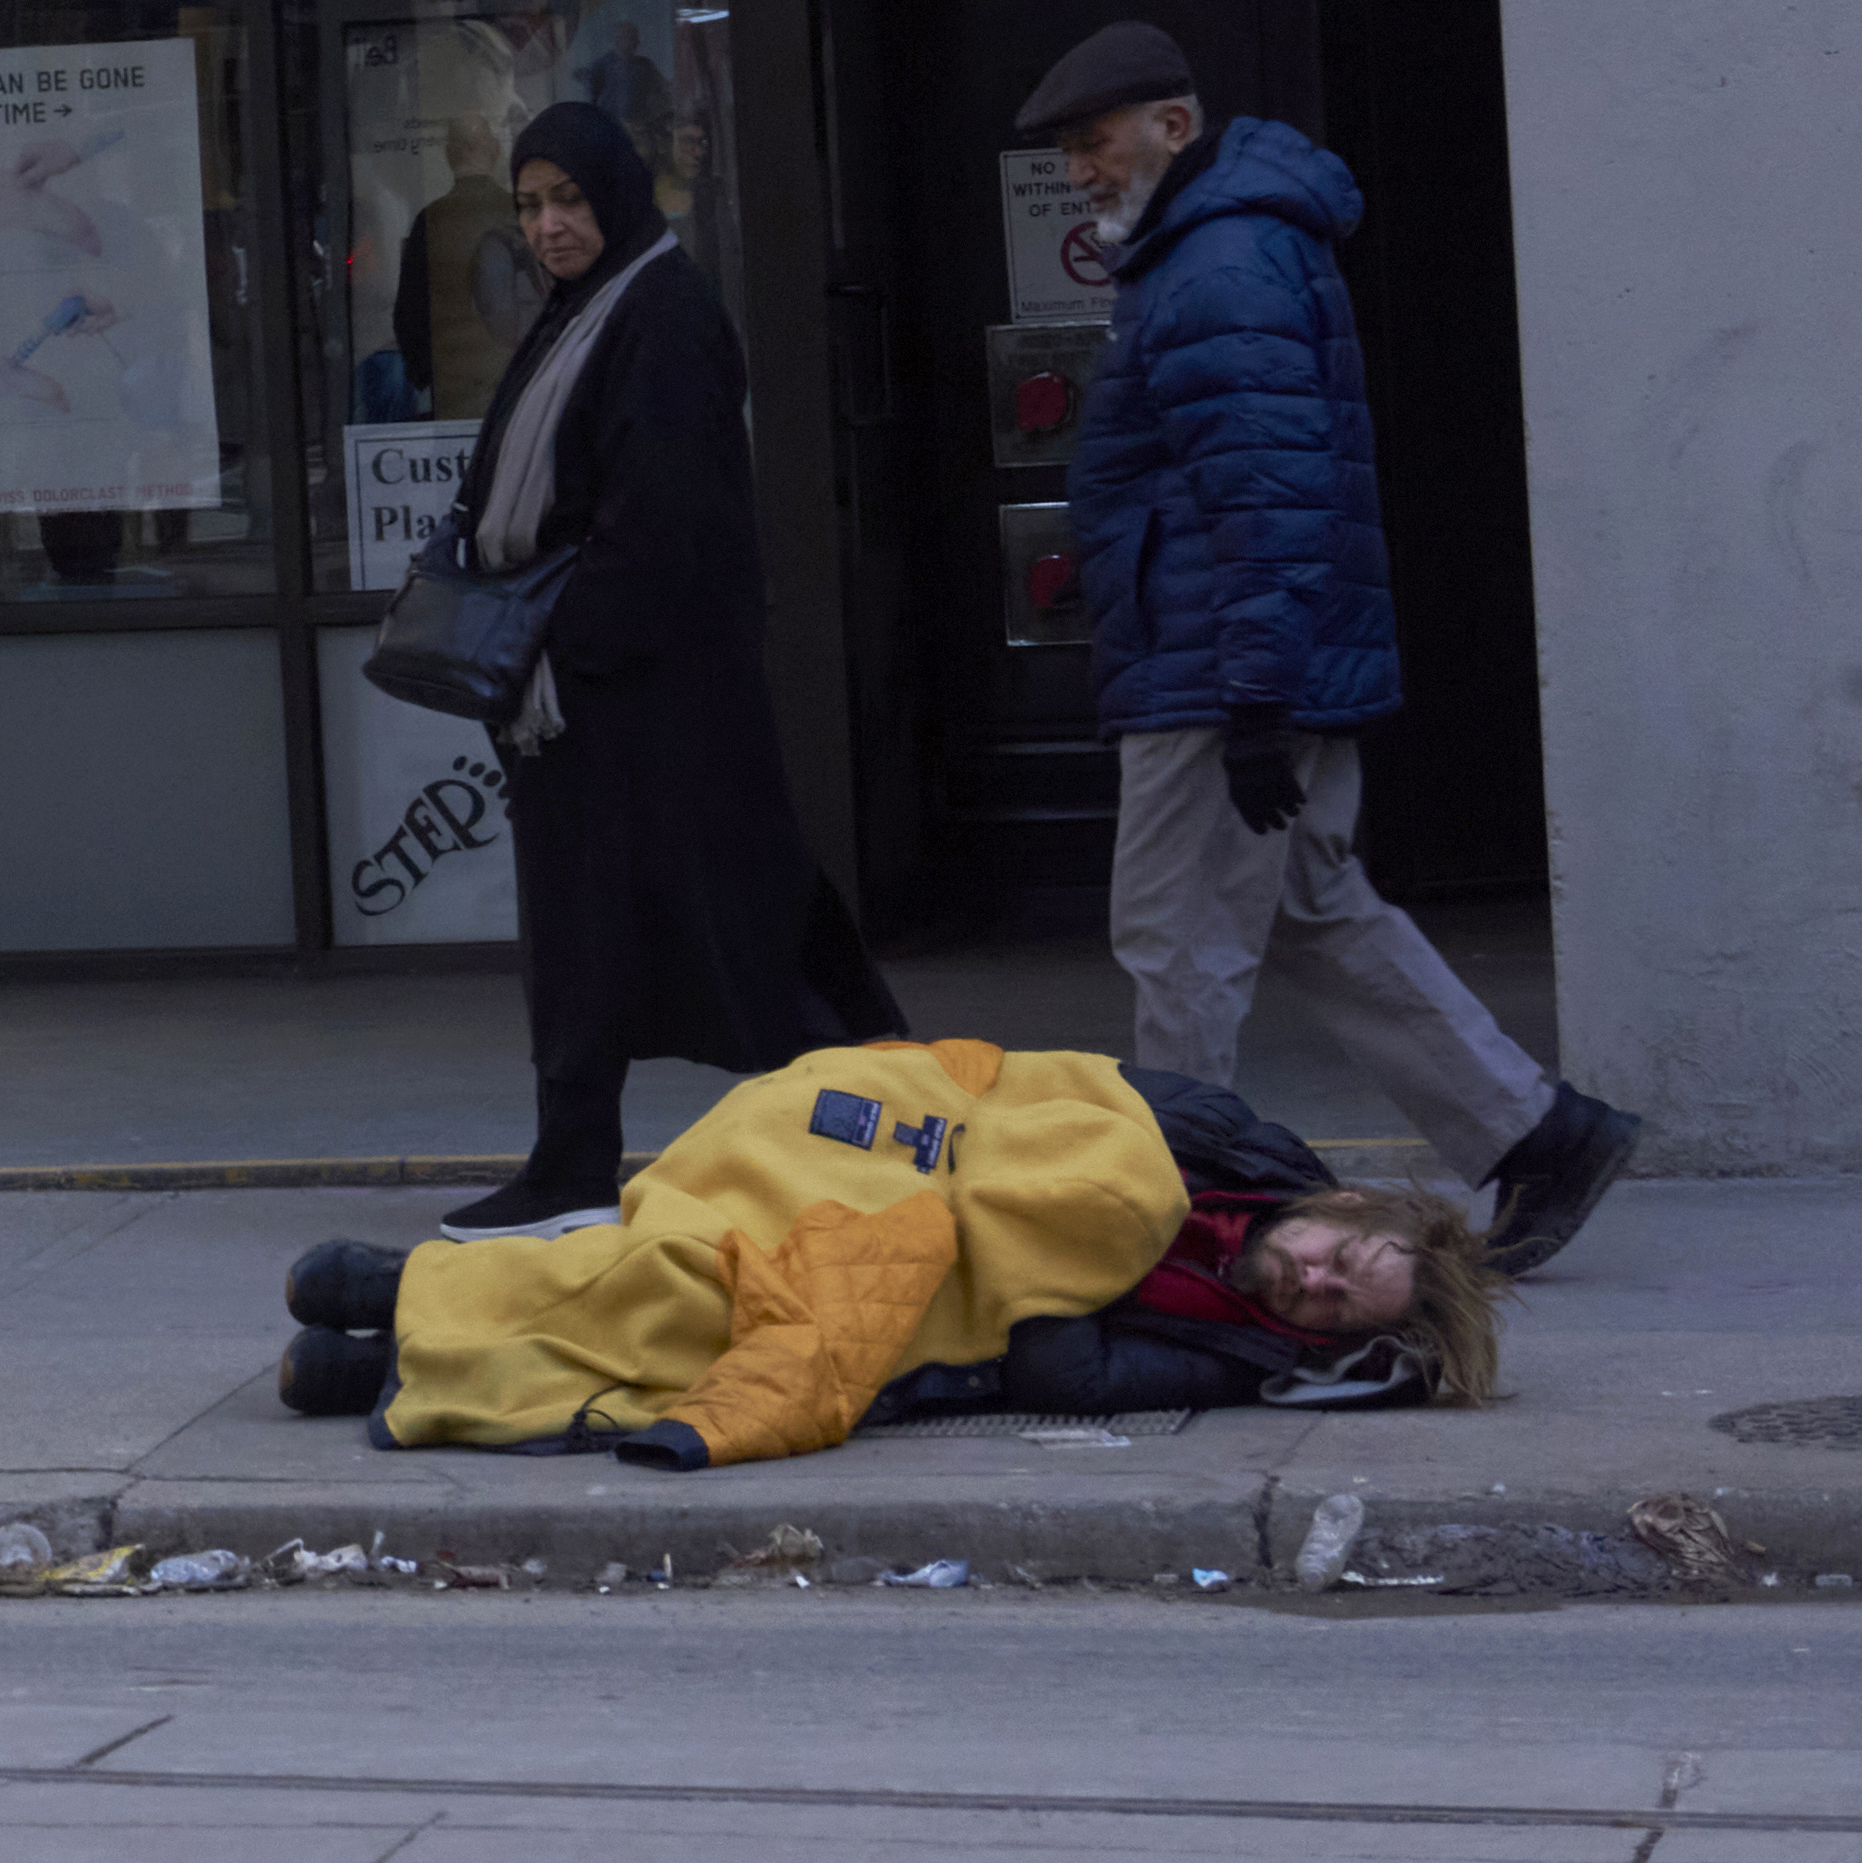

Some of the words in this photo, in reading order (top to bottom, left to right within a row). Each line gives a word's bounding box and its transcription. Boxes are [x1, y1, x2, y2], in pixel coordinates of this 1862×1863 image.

[37, 70, 68, 92] BE
[79, 66, 146, 90] GONE
[1031, 161, 1056, 175] NO
[1013, 181, 1071, 196] WITHIN
[1029, 203, 1052, 217] OF
[1061, 201, 1093, 216] ENT
[372, 447, 469, 486] Cust
[372, 505, 437, 542] Pla
[350, 777, 500, 917] STEP
